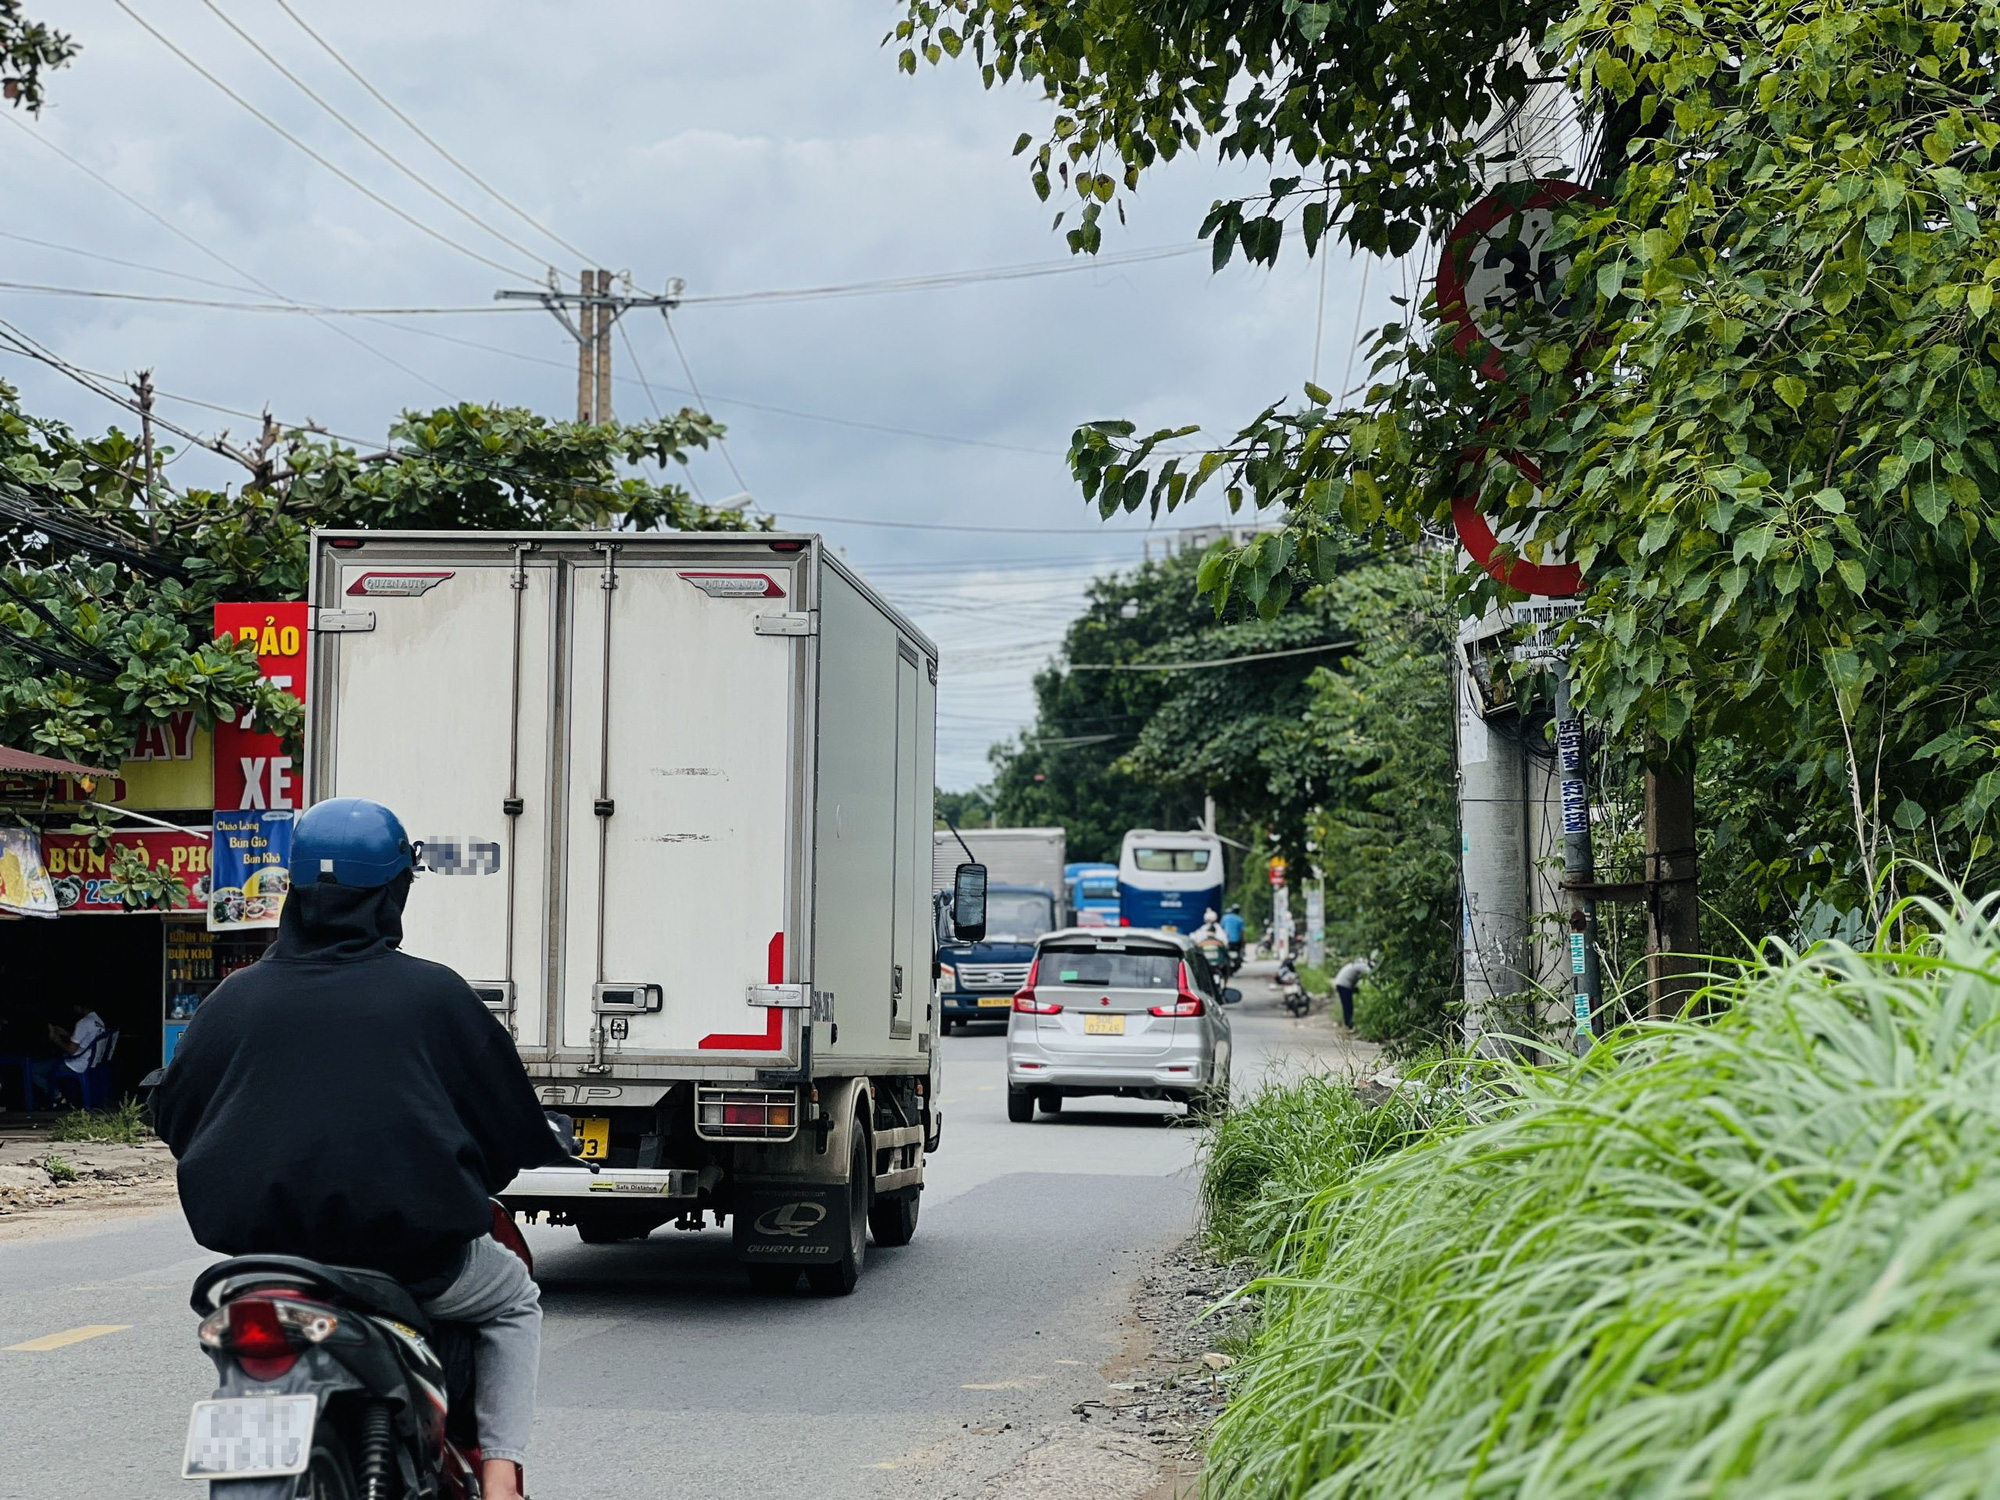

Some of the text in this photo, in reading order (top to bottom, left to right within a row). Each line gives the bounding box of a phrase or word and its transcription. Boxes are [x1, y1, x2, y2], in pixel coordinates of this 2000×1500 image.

[1518, 608, 1532, 623] CHO
[1533, 604, 1552, 623] THUÊ
[239, 757, 293, 810] XE
[50, 841, 105, 874] BÚN
[171, 846, 212, 873] PH
